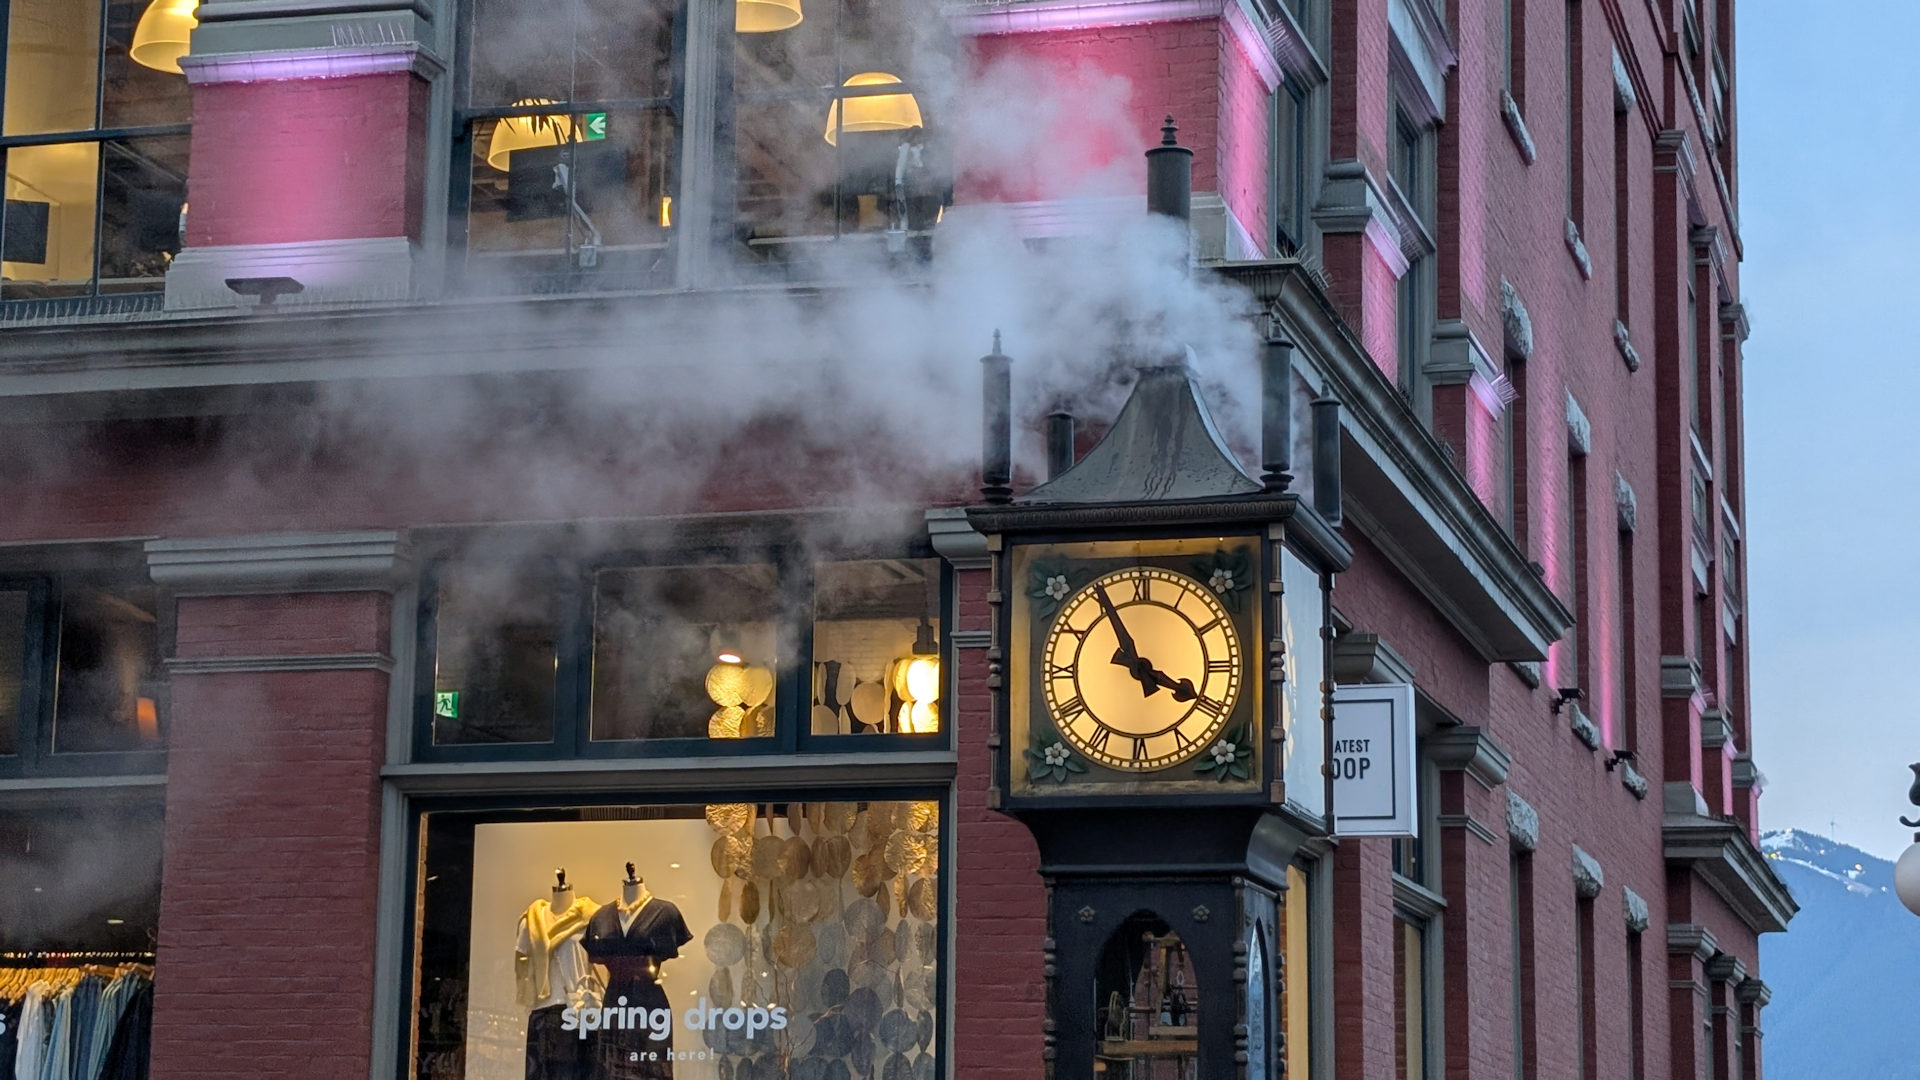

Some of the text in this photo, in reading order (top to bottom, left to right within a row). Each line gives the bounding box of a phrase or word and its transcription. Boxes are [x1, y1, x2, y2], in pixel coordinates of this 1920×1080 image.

[1133, 579, 1151, 601] XII
[1061, 622, 1086, 642] X
[1199, 617, 1222, 636] II
[1052, 664, 1074, 679] IX
[1208, 660, 1230, 673] III
[1133, 738, 1148, 759] VI
[1174, 728, 1192, 750] V
[1334, 739, 1371, 753] ATEST
[1333, 757, 1371, 780] OOP
[561, 995, 788, 1041] spring drops
[629, 1047, 715, 1062] are here!
